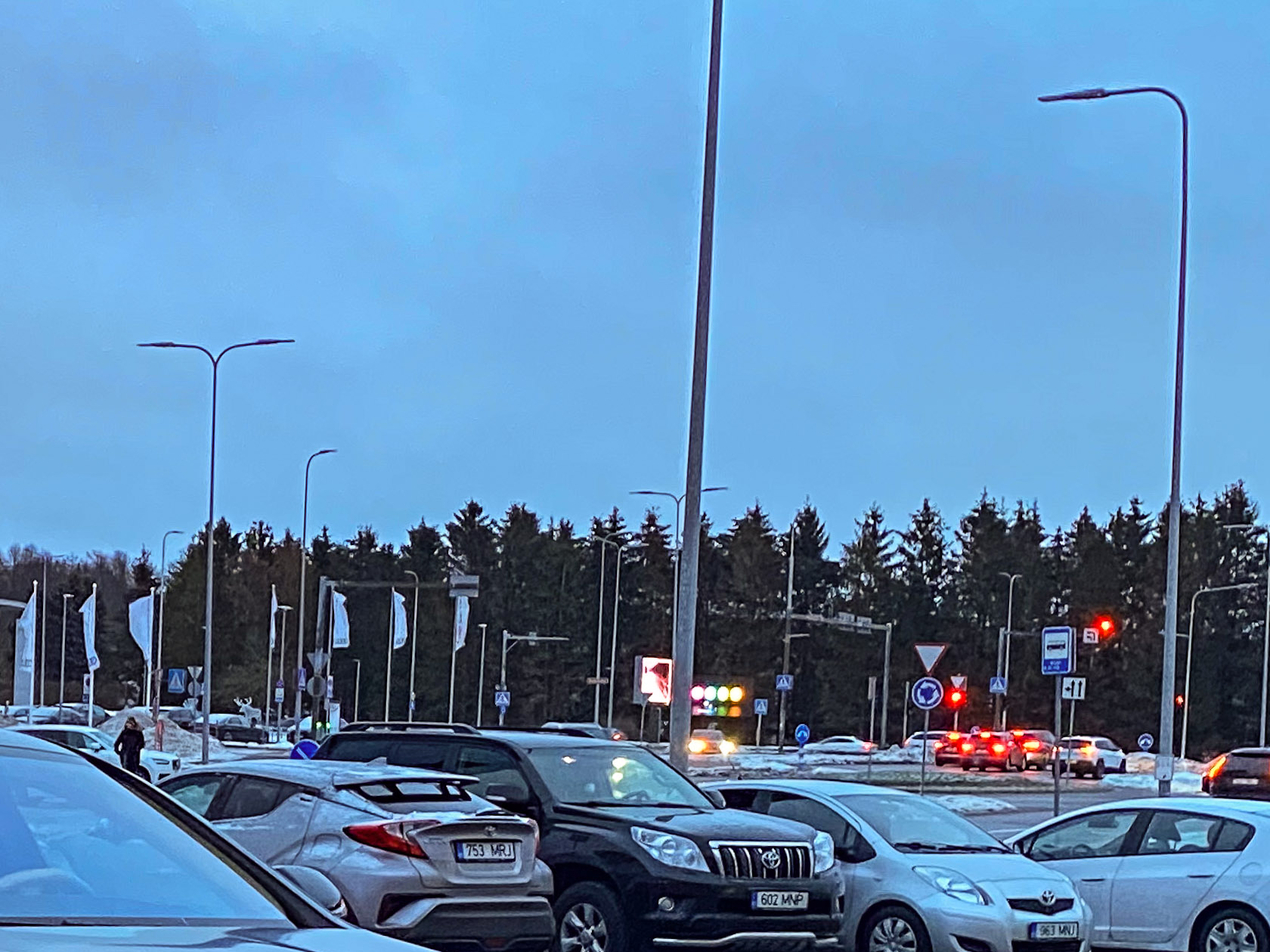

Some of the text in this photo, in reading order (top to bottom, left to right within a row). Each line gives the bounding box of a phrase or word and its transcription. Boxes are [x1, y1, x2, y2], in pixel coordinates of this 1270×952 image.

[466, 843, 512, 857] 753 MRJ
[761, 893, 804, 906] 602 MNP
